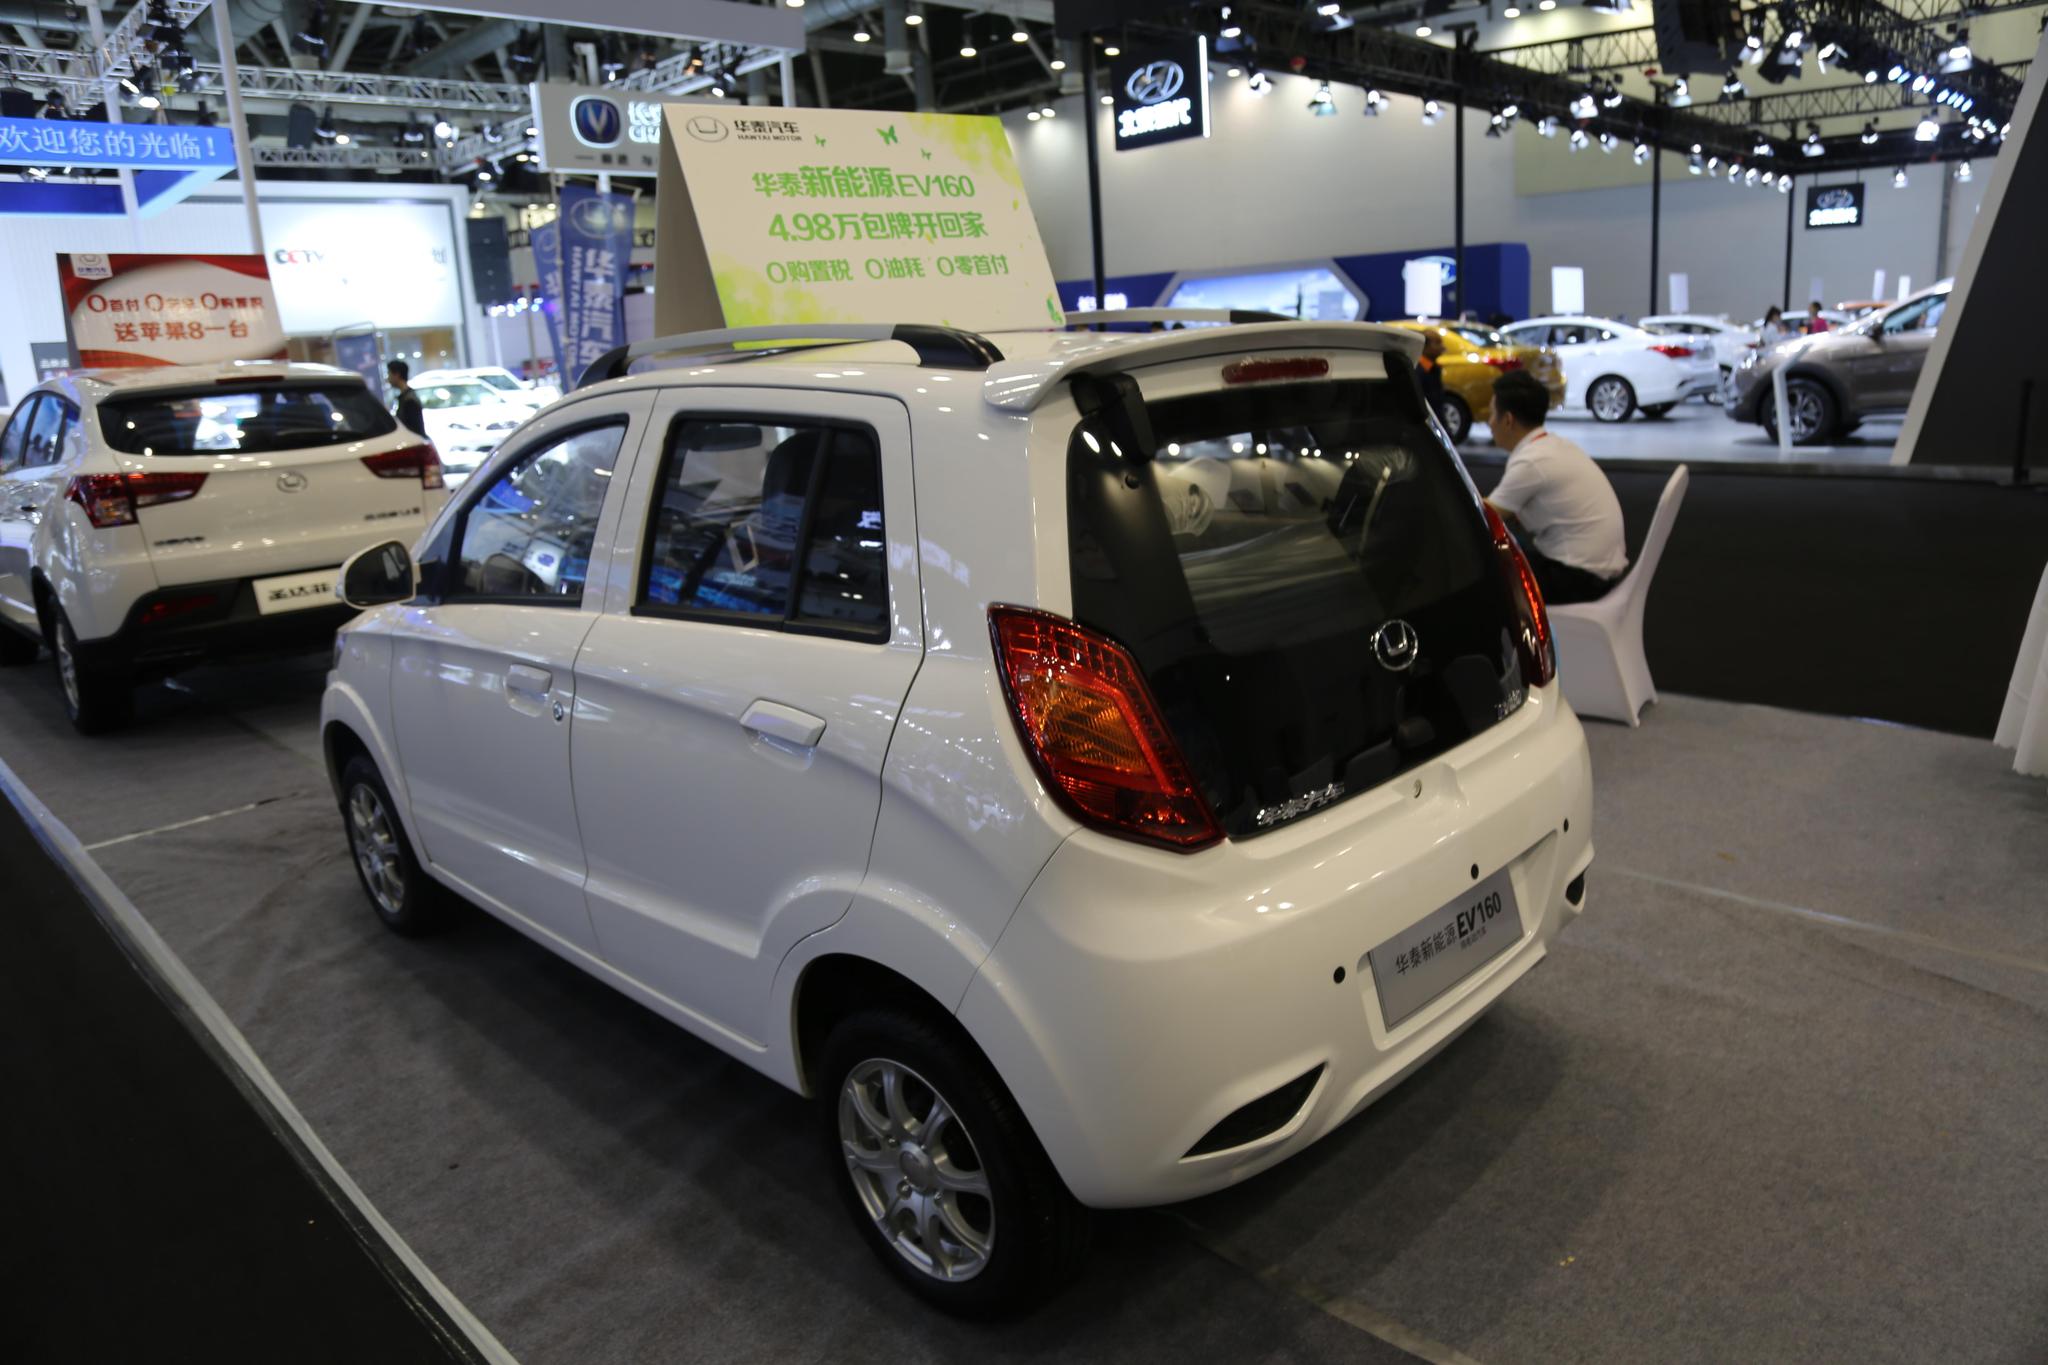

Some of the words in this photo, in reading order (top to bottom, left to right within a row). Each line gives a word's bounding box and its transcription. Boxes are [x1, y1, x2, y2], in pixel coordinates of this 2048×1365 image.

[734, 120, 799, 133] 华泰汽车
[752, 165, 975, 199] 华泰新能源EV160
[769, 210, 988, 241] 4.98万包牌开回家
[114, 319, 249, 343] 送苹果8一台
[1395, 892, 1502, 976] 华泰新能源EV160
